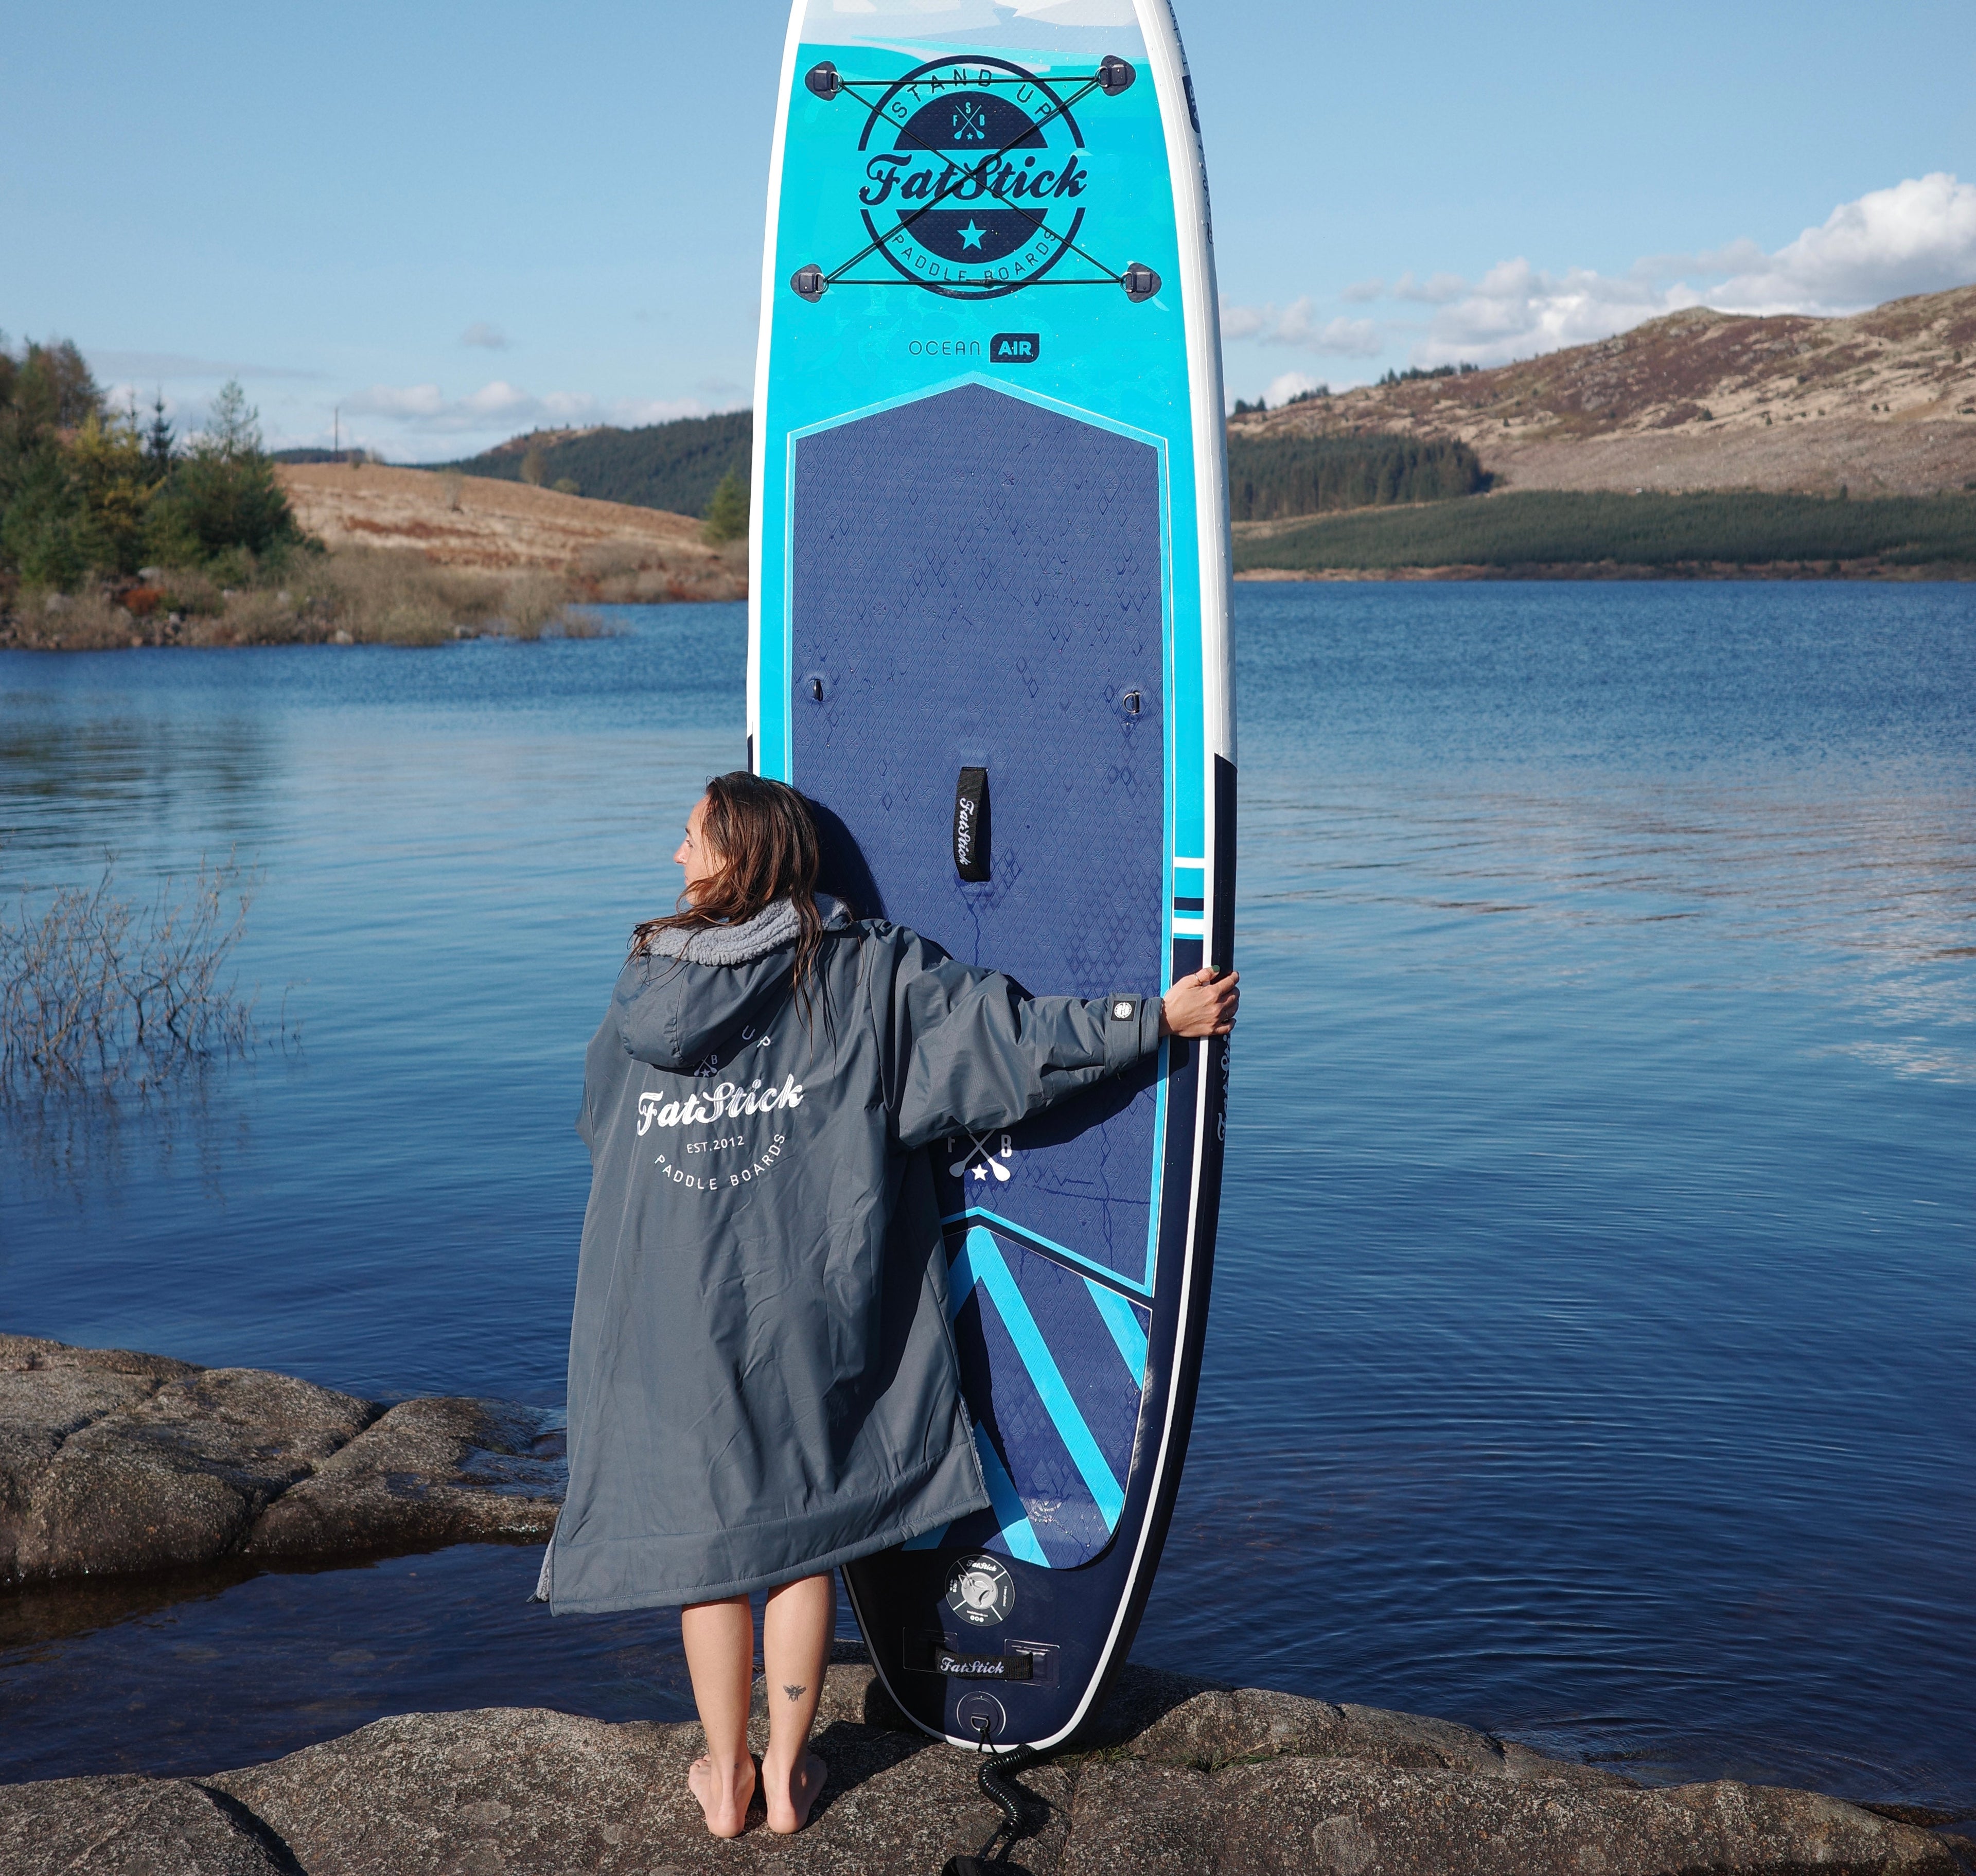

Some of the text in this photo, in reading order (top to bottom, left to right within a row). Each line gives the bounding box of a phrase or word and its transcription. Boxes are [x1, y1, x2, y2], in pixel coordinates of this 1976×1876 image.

[892, 68, 1052, 118] STAND UP
[858, 153, 1088, 206] FatStick
[892, 235, 967, 281] PADDLE
[909, 341, 1032, 356] OCEAN AIR
[958, 798, 974, 865] FatStick
[637, 1073, 804, 1136] FatStick
[655, 1134, 785, 1190] PADDLE BOARDS
[686, 1136, 745, 1154] EST.2012
[966, 1560, 997, 1572] FatStick
[940, 1657, 1004, 1674] FatStick
